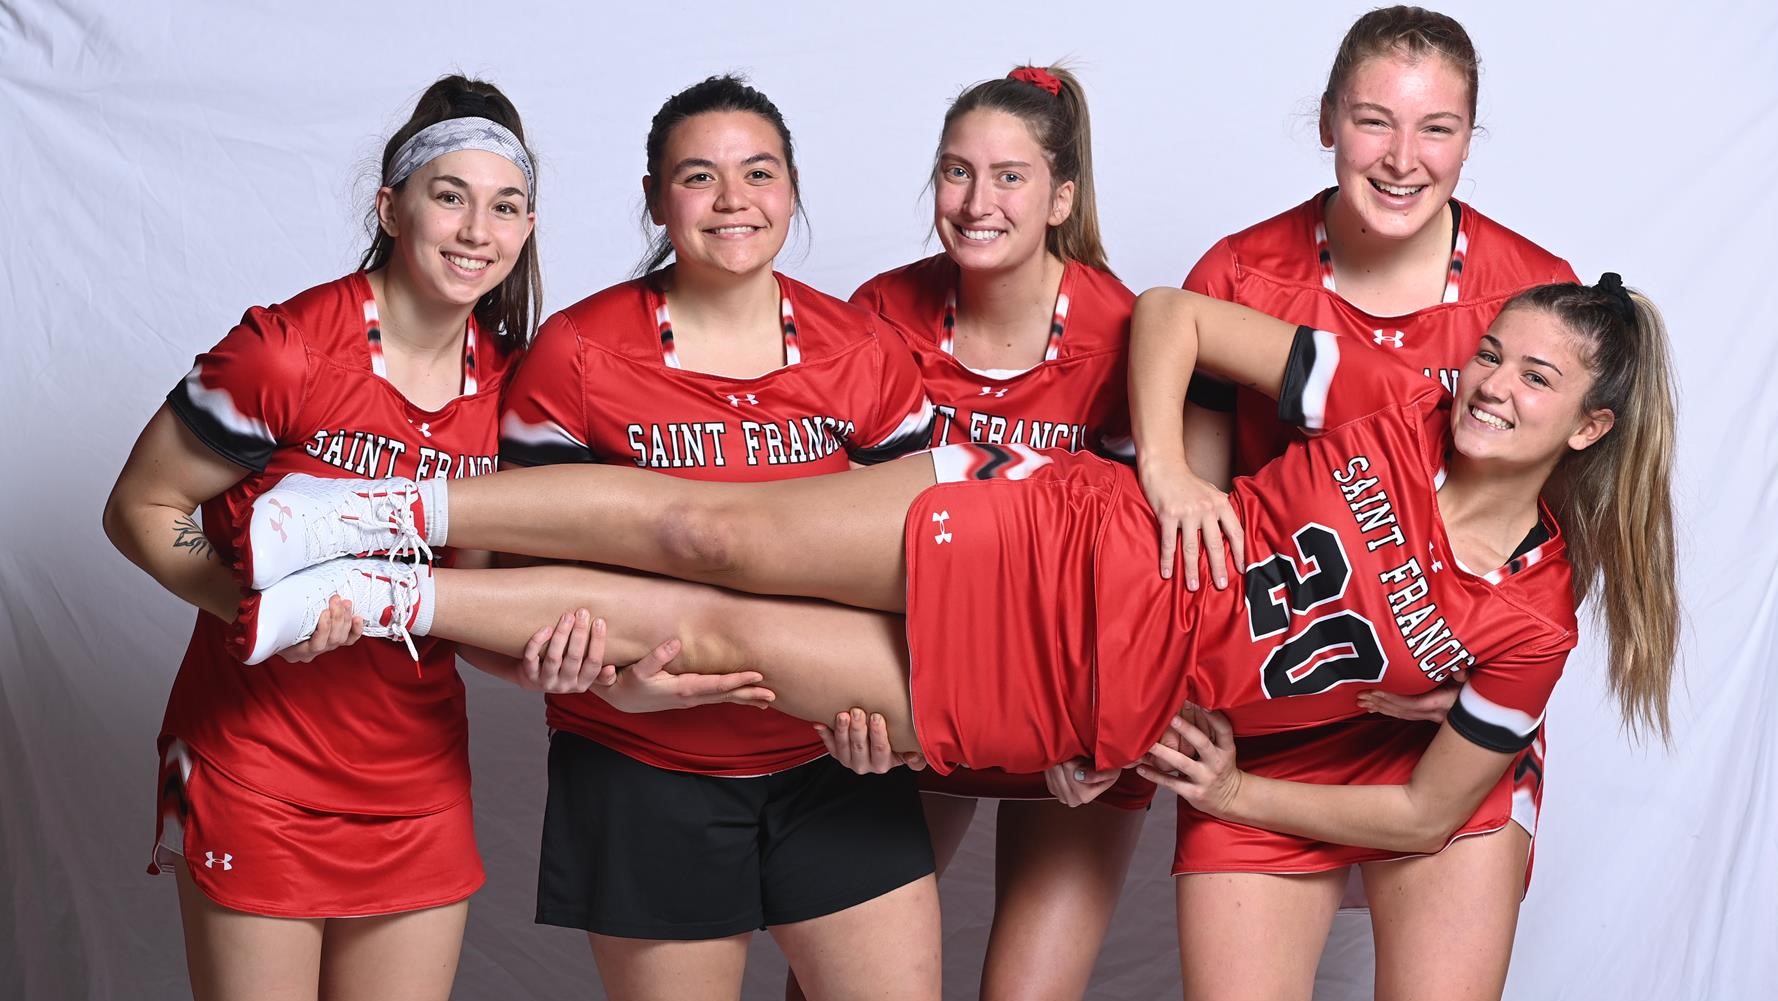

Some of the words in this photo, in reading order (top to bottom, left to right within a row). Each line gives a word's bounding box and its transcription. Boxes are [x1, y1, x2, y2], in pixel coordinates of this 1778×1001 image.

[304, 428, 406, 480] SAINT
[627, 421, 728, 468] SAINT
[969, 411, 1088, 453] FRANCI
[1332, 455, 1406, 552] SAINT
[1245, 521, 1390, 700] 20
